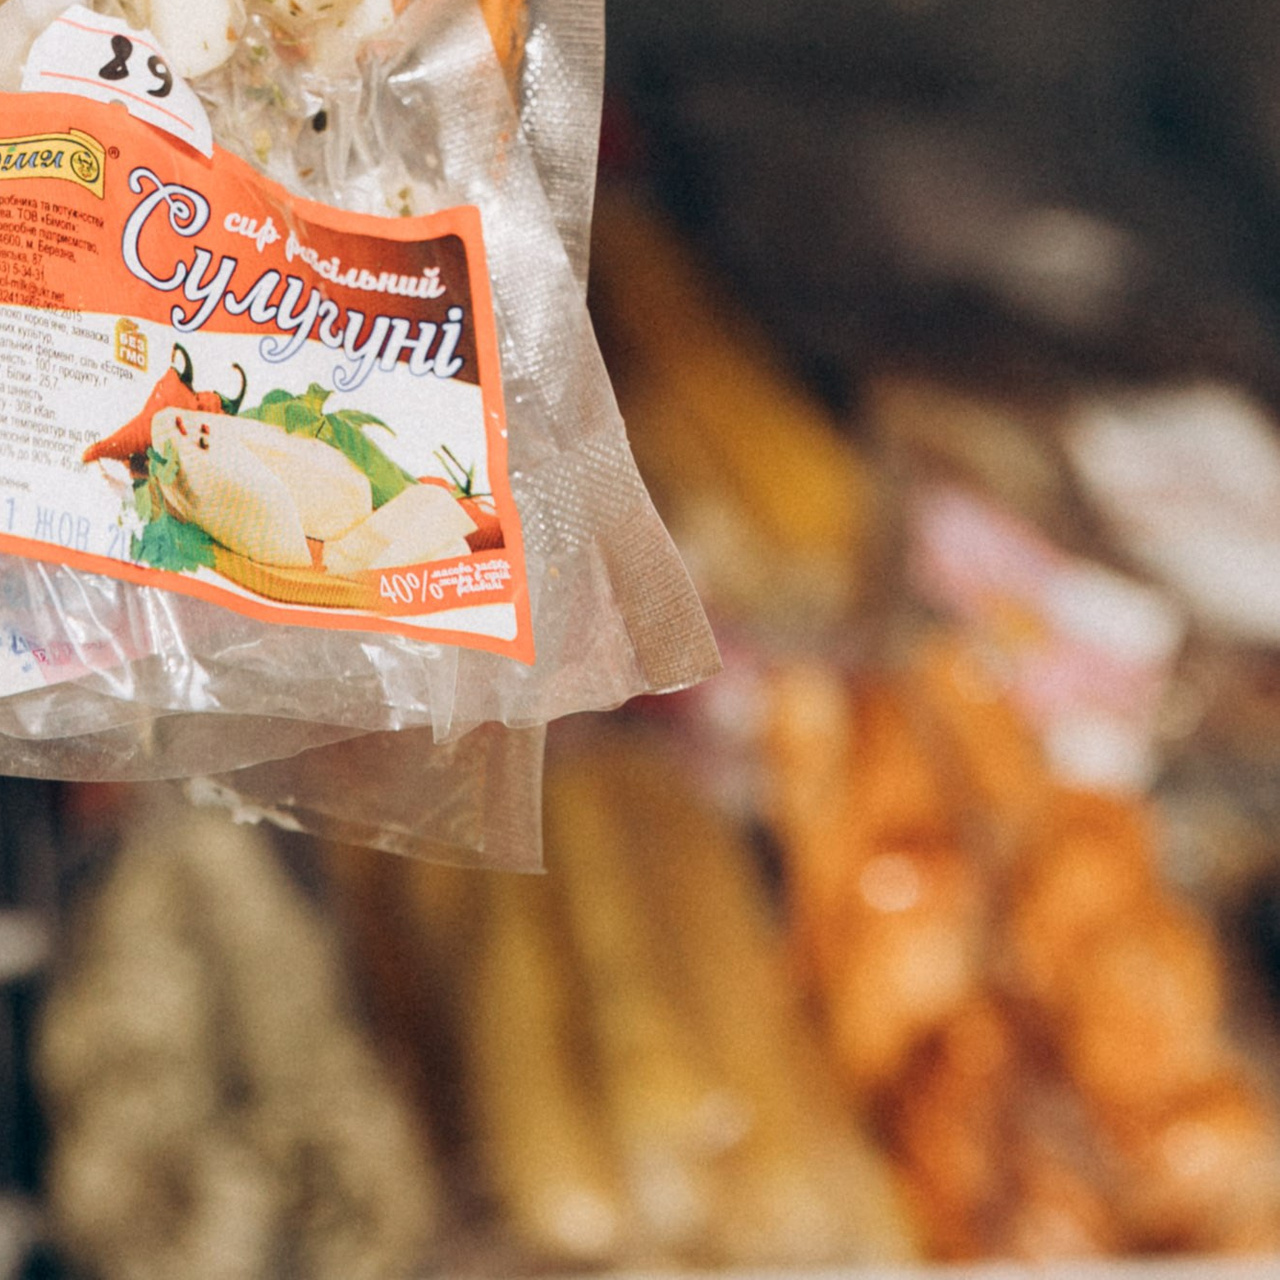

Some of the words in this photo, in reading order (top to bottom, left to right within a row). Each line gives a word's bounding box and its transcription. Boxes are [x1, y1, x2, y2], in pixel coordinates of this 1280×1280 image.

[18, 208, 38, 223] ТОВ
[40, 200, 51, 212] та
[224, 212, 282, 252] сир
[122, 166, 464, 392] Сулугуні
[120, 332, 145, 353] БЕЗ
[120, 346, 145, 366] ГМО
[379, 569, 444, 604] 40%
